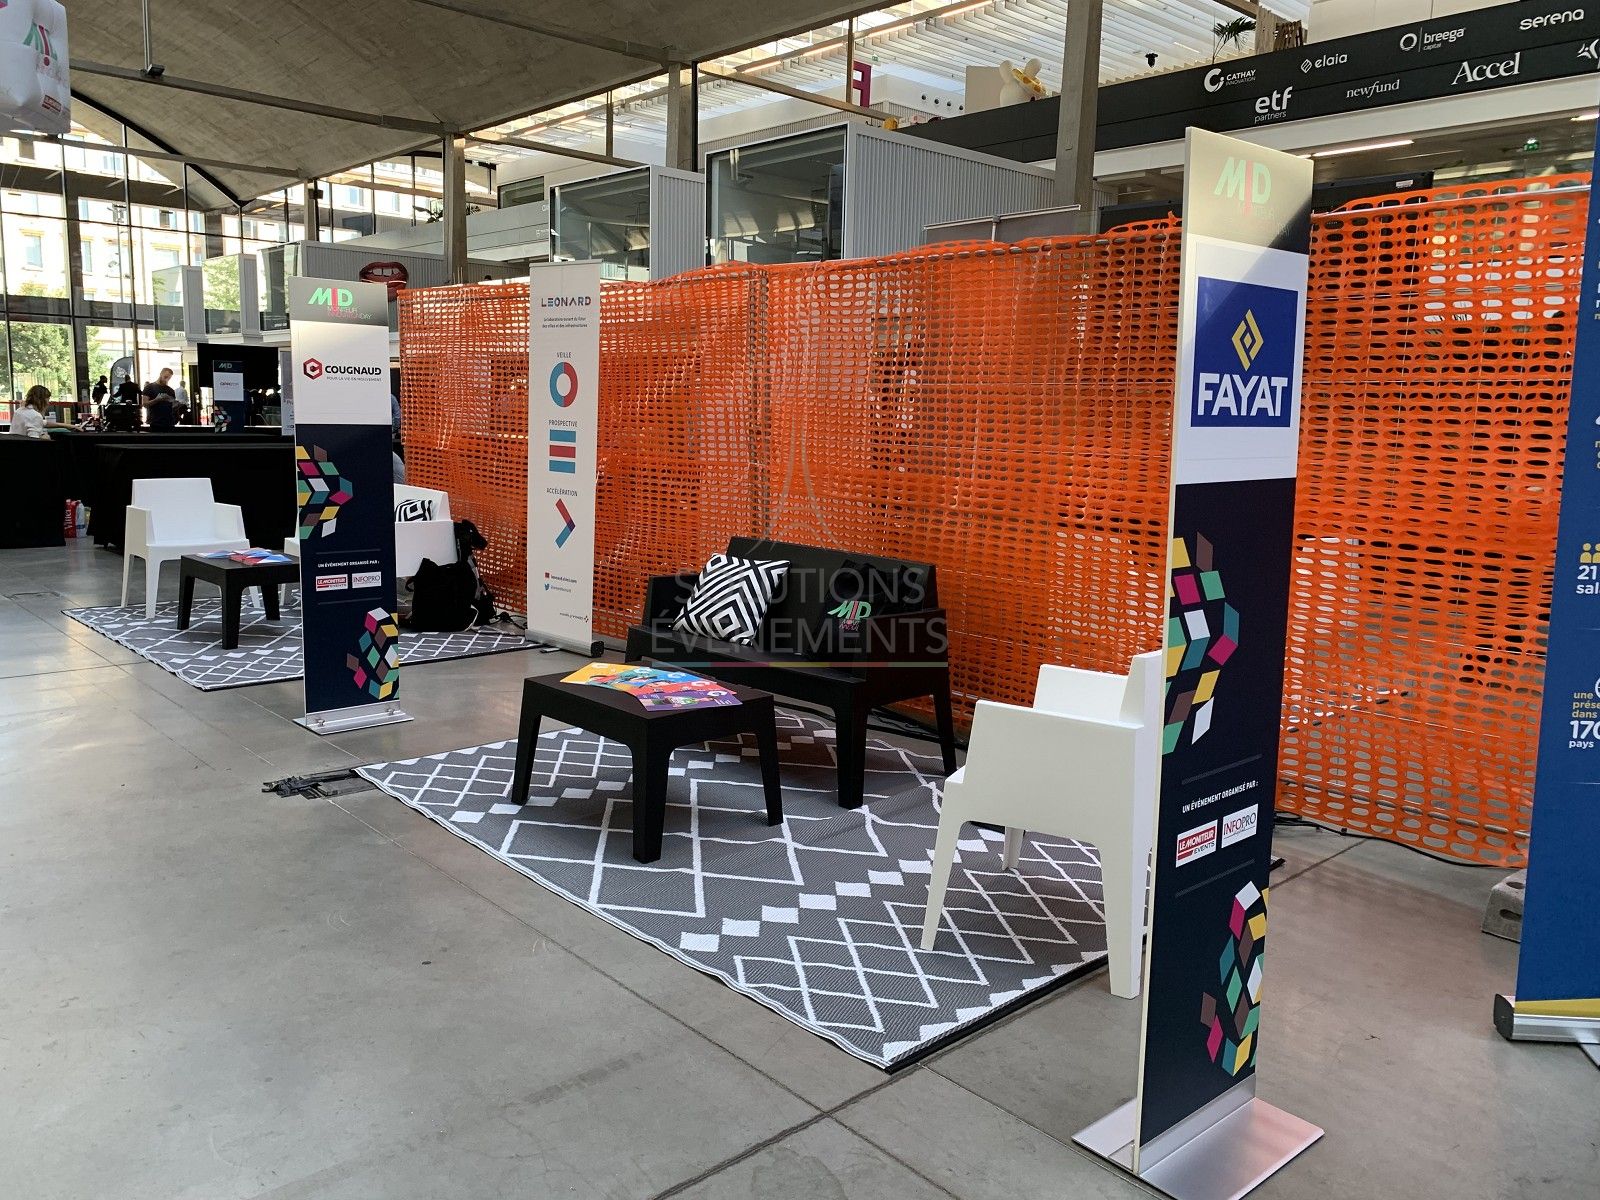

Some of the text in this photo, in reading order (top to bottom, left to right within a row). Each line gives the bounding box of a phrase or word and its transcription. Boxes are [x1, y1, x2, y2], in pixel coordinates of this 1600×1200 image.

[1519, 8, 1584, 31] serena
[1424, 28, 1465, 44] breega
[1314, 53, 1348, 69] elaia
[1450, 52, 1521, 86] Accel
[1225, 76, 1256, 86] INNOVATION
[1226, 69, 1256, 81] CATHAY
[1346, 79, 1400, 98] newfund
[1254, 86, 1293, 114] etf
[1254, 111, 1287, 124] partners
[541, 296, 592, 307] LEONARD
[325, 365, 382, 376] COUGNAUD
[1197, 373, 1288, 417] FAYAT
[548, 419, 577, 428] PROSPECTIVE
[1571, 710, 1597, 718] dans
[1568, 740, 1594, 749] pays
[1182, 804, 1191, 813] UN
[1221, 781, 1246, 799] ORGANISÉ
[1246, 780, 1256, 790] PAR
[1223, 812, 1257, 836] INFOPRO
[1179, 829, 1214, 851] LE MONITEUR
[1193, 840, 1215, 855] EVENTS
